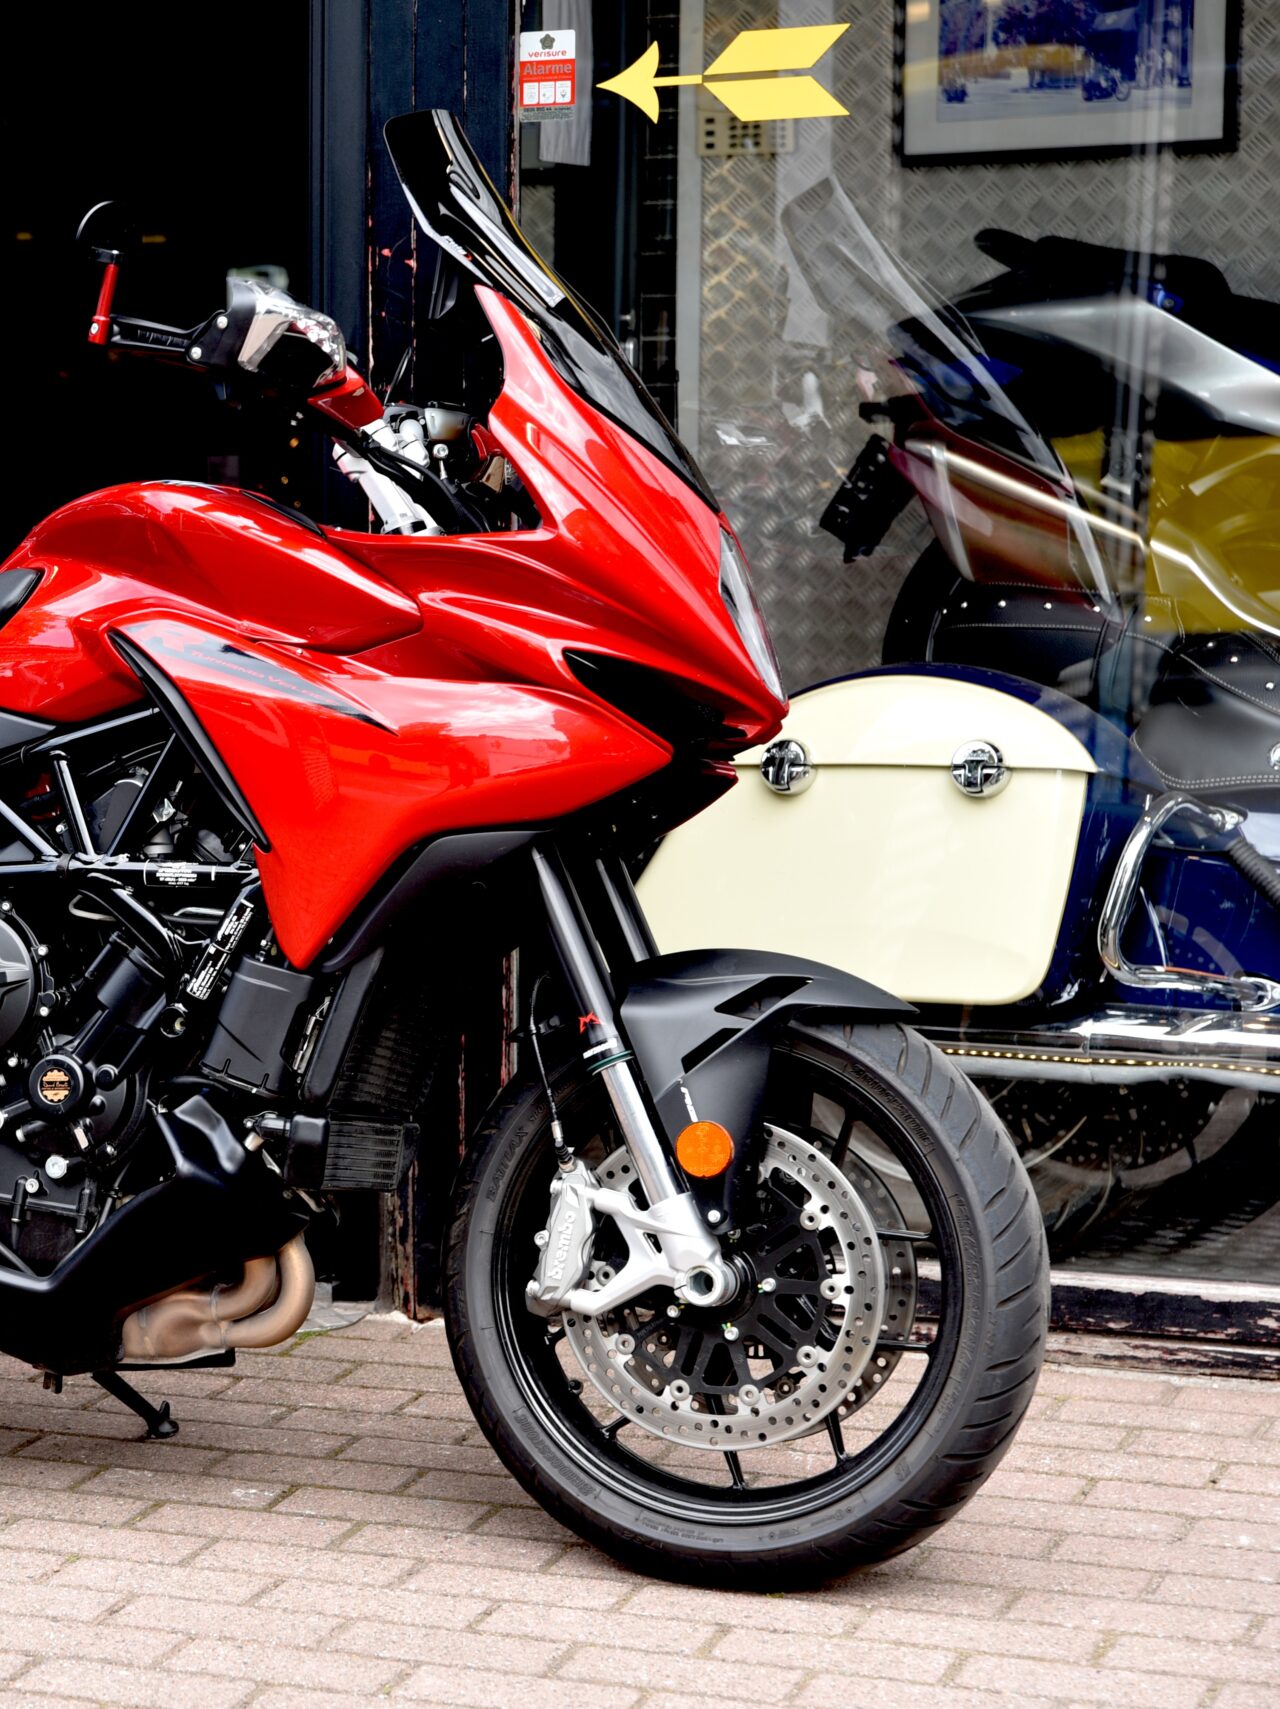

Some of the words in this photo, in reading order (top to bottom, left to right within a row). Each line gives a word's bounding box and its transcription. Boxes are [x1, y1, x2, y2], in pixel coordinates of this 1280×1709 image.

[528, 49, 567, 58] verisure
[523, 62, 572, 76] Alarme
[546, 1210, 577, 1281] brembo
